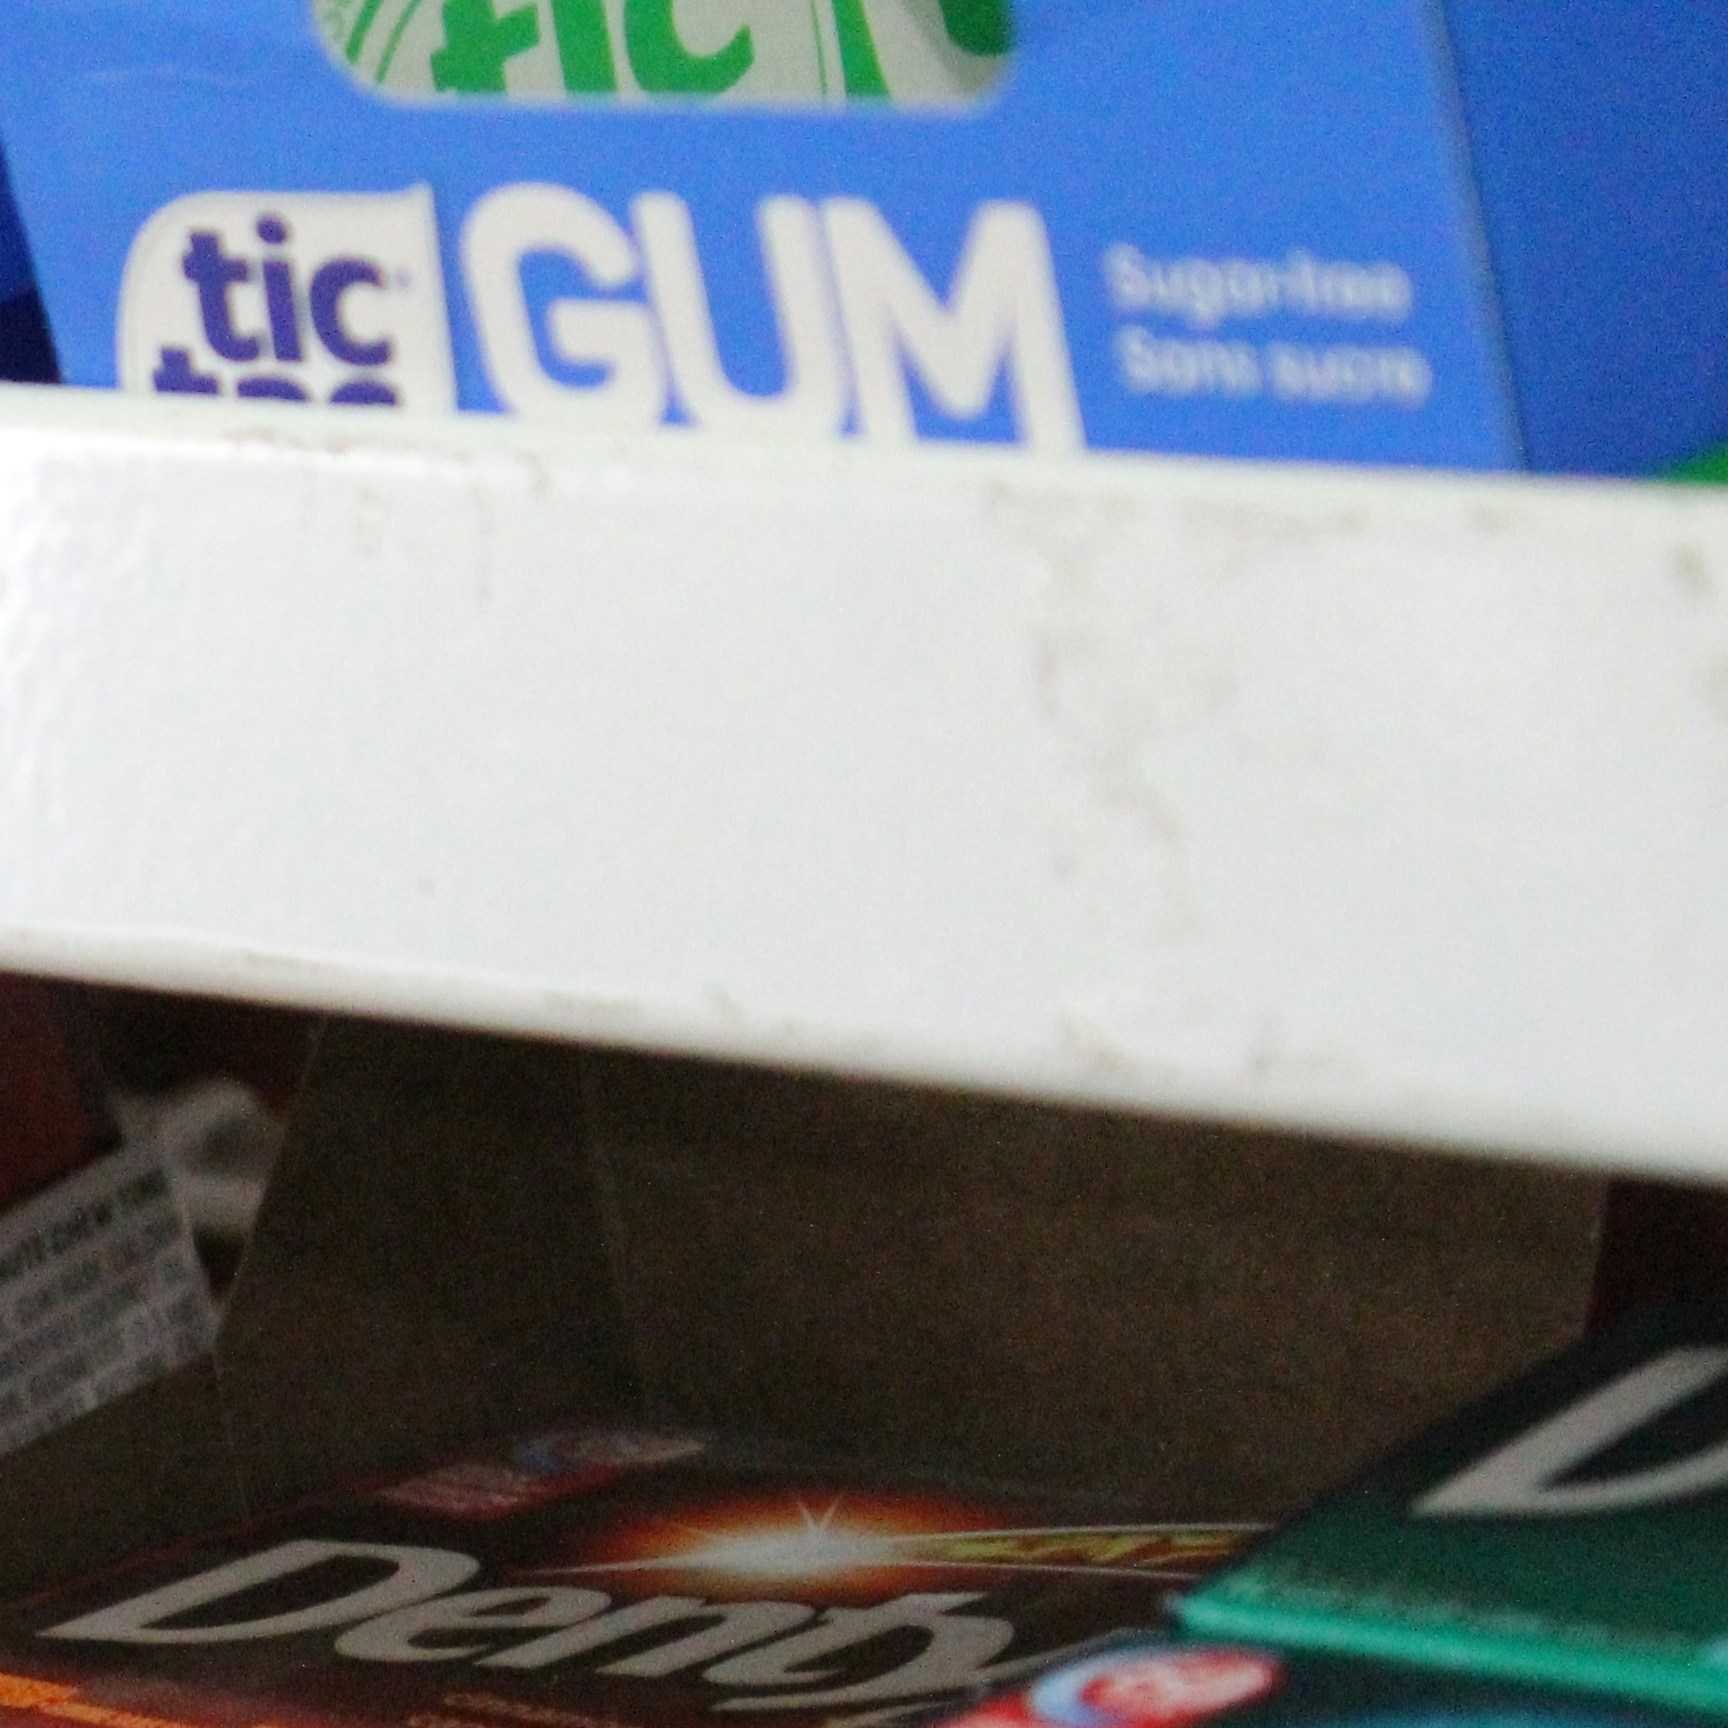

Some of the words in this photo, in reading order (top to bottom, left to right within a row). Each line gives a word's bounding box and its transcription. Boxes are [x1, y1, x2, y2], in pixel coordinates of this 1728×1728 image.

[181, 214, 391, 368] tic
[461, 180, 1086, 450] GUM
[1101, 243, 1413, 322] Sugar-free
[36, 1537, 1138, 1712] Denty
